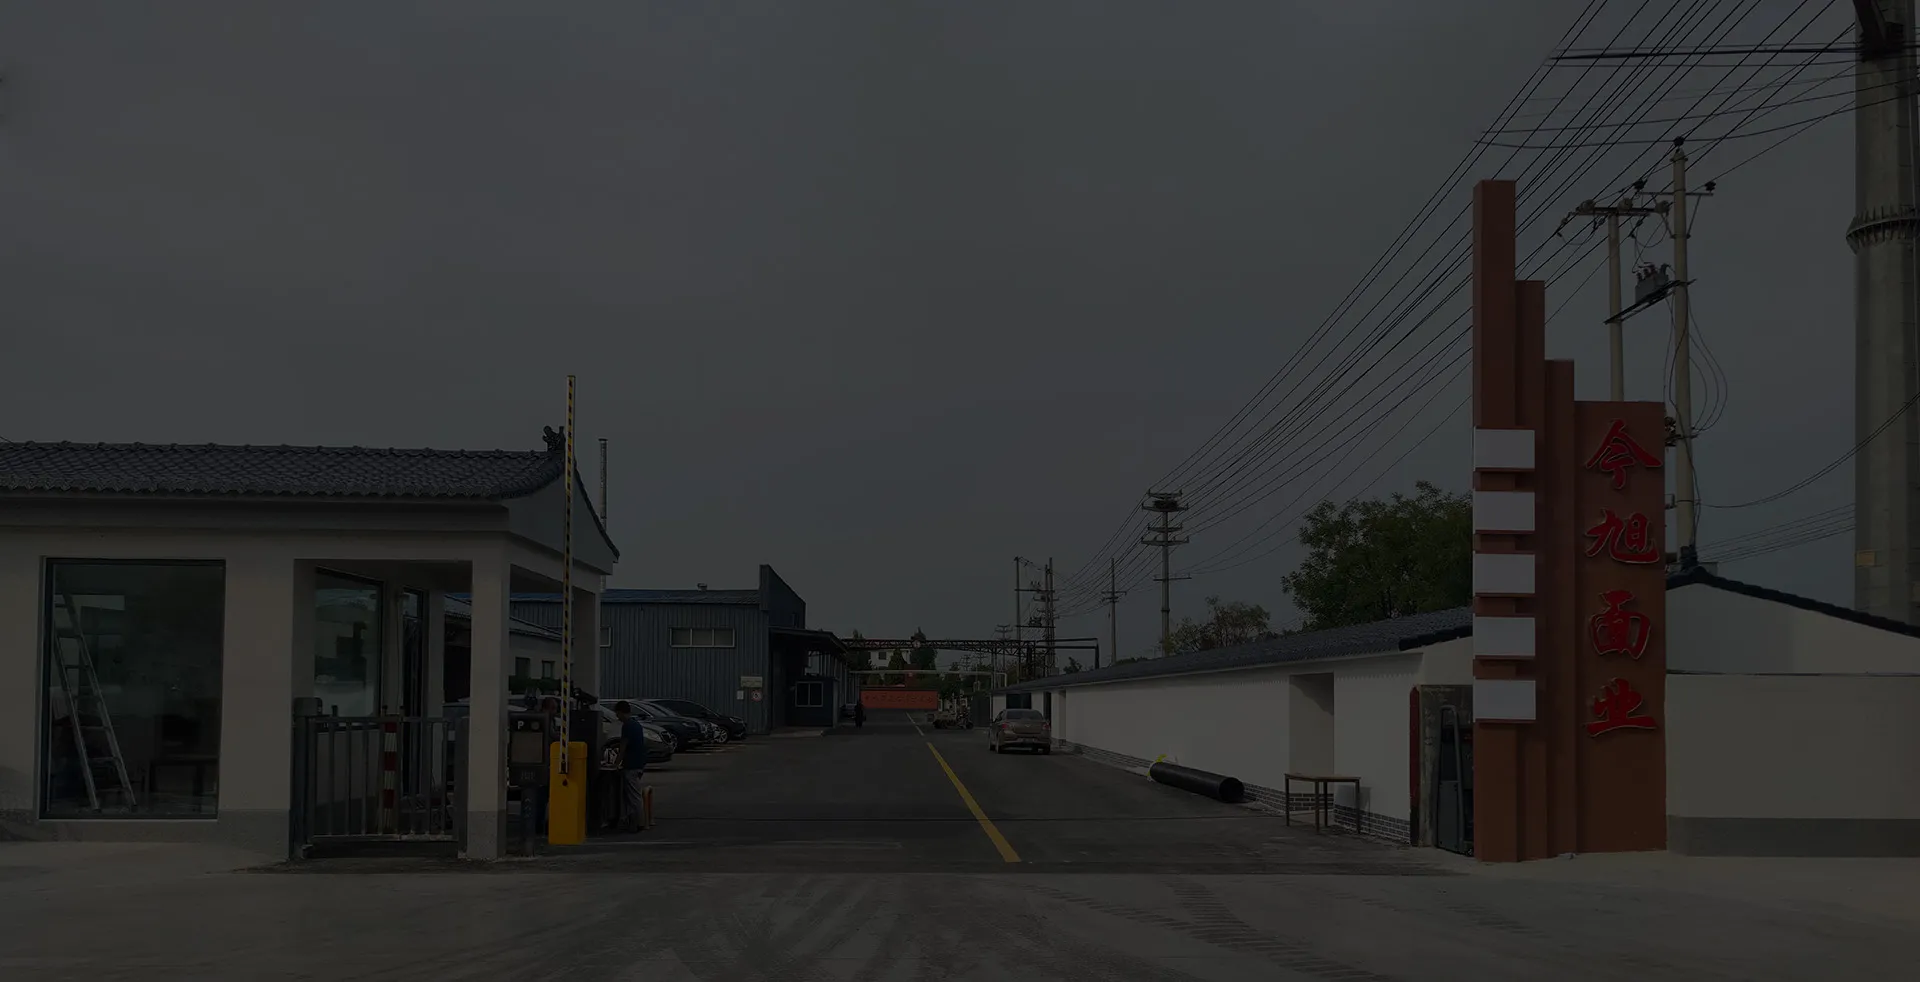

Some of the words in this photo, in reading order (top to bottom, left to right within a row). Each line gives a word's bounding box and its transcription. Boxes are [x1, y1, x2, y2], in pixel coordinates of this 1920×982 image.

[1585, 419, 1663, 738] 今旭面业
[517, 720, 525, 730] P
